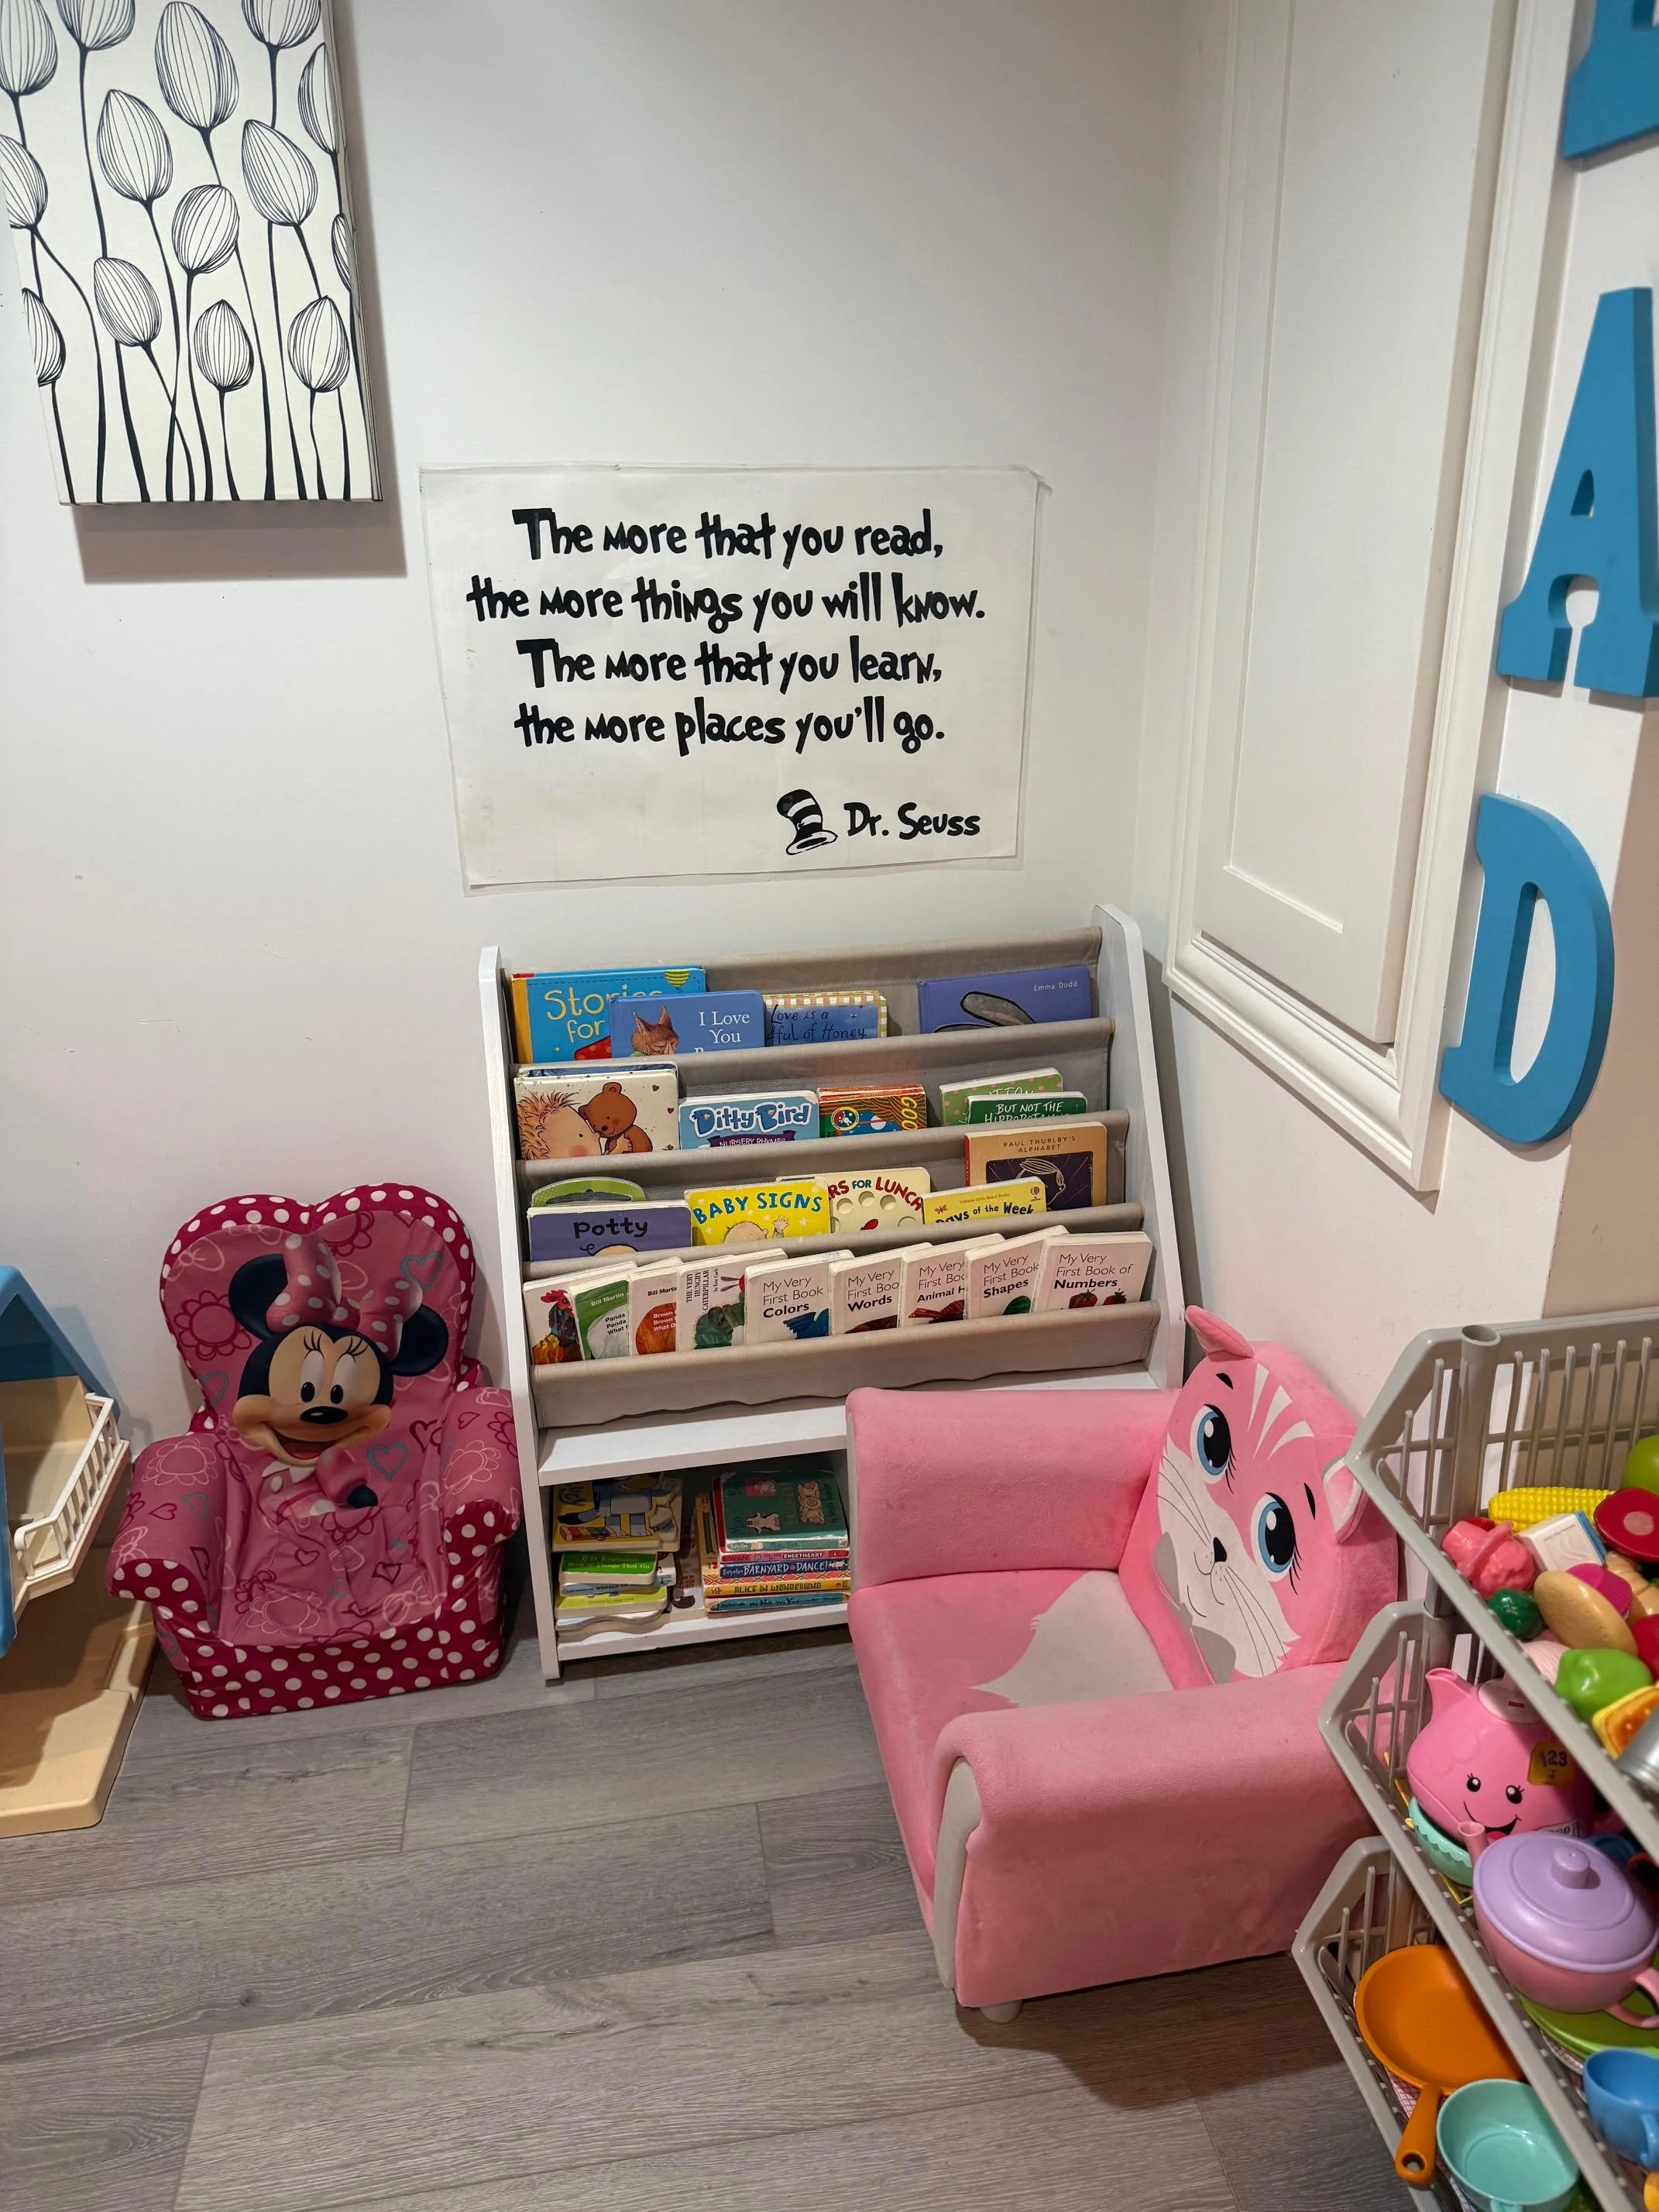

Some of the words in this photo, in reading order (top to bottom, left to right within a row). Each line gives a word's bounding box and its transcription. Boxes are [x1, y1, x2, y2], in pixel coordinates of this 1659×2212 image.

[512, 508, 592, 560] The
[696, 512, 775, 559] that
[783, 524, 843, 569] you
[855, 508, 943, 558] read,
[466, 575, 529, 621] the
[631, 576, 743, 634] things
[753, 589, 812, 633] you
[822, 572, 881, 621] will
[891, 572, 984, 627] know.
[516, 638, 595, 688] The
[695, 641, 773, 685] that
[780, 652, 838, 695] you
[850, 635, 941, 684] learn,
[514, 702, 575, 747] the
[675, 697, 785, 757] places
[795, 696, 884, 754] you'll
[894, 712, 944, 754] go.
[844, 802, 888, 836] Dr.
[898, 802, 980, 840] Seuss
[1033, 983, 1055, 991] Emma
[1058, 981, 1077, 989] Dodd
[699, 1012, 705, 1026] I
[711, 1011, 750, 1025] Love
[771, 1004, 799, 1024] Love
[803, 1011, 816, 1019] is
[567, 1019, 605, 1043] for
[709, 1029, 741, 1044] You
[767, 1023, 799, 1045] dful
[804, 1022, 817, 1041] of
[995, 1103, 1018, 1115] BUT
[1019, 1102, 1042, 1112] NOT
[1042, 1101, 1064, 1112] THE
[692, 1107, 754, 1135] Ditty
[756, 1103, 811, 1131] Bird
[720, 1138, 755, 1147] NURSERY
[1018, 1144, 1061, 1153] ALPHABET
[1029, 1135, 1076, 1146] THURLBY'S
[828, 1180, 850, 1200] RS
[851, 1179, 872, 1190] FOR
[875, 1176, 922, 1211] LUNCH
[692, 1196, 749, 1224] BABY
[757, 1191, 823, 1213] SIGNS
[973, 1206, 981, 1214] of
[1003, 1202, 1034, 1214] Week
[984, 1262, 1001, 1274] My
[1002, 1254, 1029, 1268] Very
[1059, 1253, 1077, 1265] My
[1079, 1252, 1108, 1265] Very
[919, 1266, 937, 1277] My
[939, 1260, 965, 1272] Very
[984, 1273, 1007, 1286] First
[1011, 1262, 1040, 1279] Book
[1056, 1266, 1081, 1277] First
[1085, 1265, 1115, 1276] Book
[1119, 1264, 1134, 1274] of
[763, 1281, 782, 1294] My
[782, 1276, 812, 1289] Very
[848, 1276, 865, 1287] My
[867, 1270, 895, 1282] Very
[919, 1277, 942, 1290] First
[946, 1273, 965, 1284] Boo
[1053, 1278, 1118, 1290] Numbers
[647, 1288, 658, 1297] Bill
[763, 1293, 788, 1306] First
[793, 1286, 824, 1300] Book
[847, 1287, 873, 1300] First
[876, 1282, 899, 1294] Boo
[917, 1287, 954, 1304] Animal
[984, 1279, 1029, 1299] Shapes
[603, 1293, 624, 1303] Martin
[847, 1294, 892, 1312] Words
[605, 1313, 626, 1323] Panda
[762, 1303, 809, 1318] Colors
[606, 1319, 627, 1329] Panda
[607, 1326, 624, 1335] What
[743, 1562, 789, 1575] BARNYARD
[795, 1560, 828, 1571] DANCE!
[1540, 1750, 1568, 1767] 123
